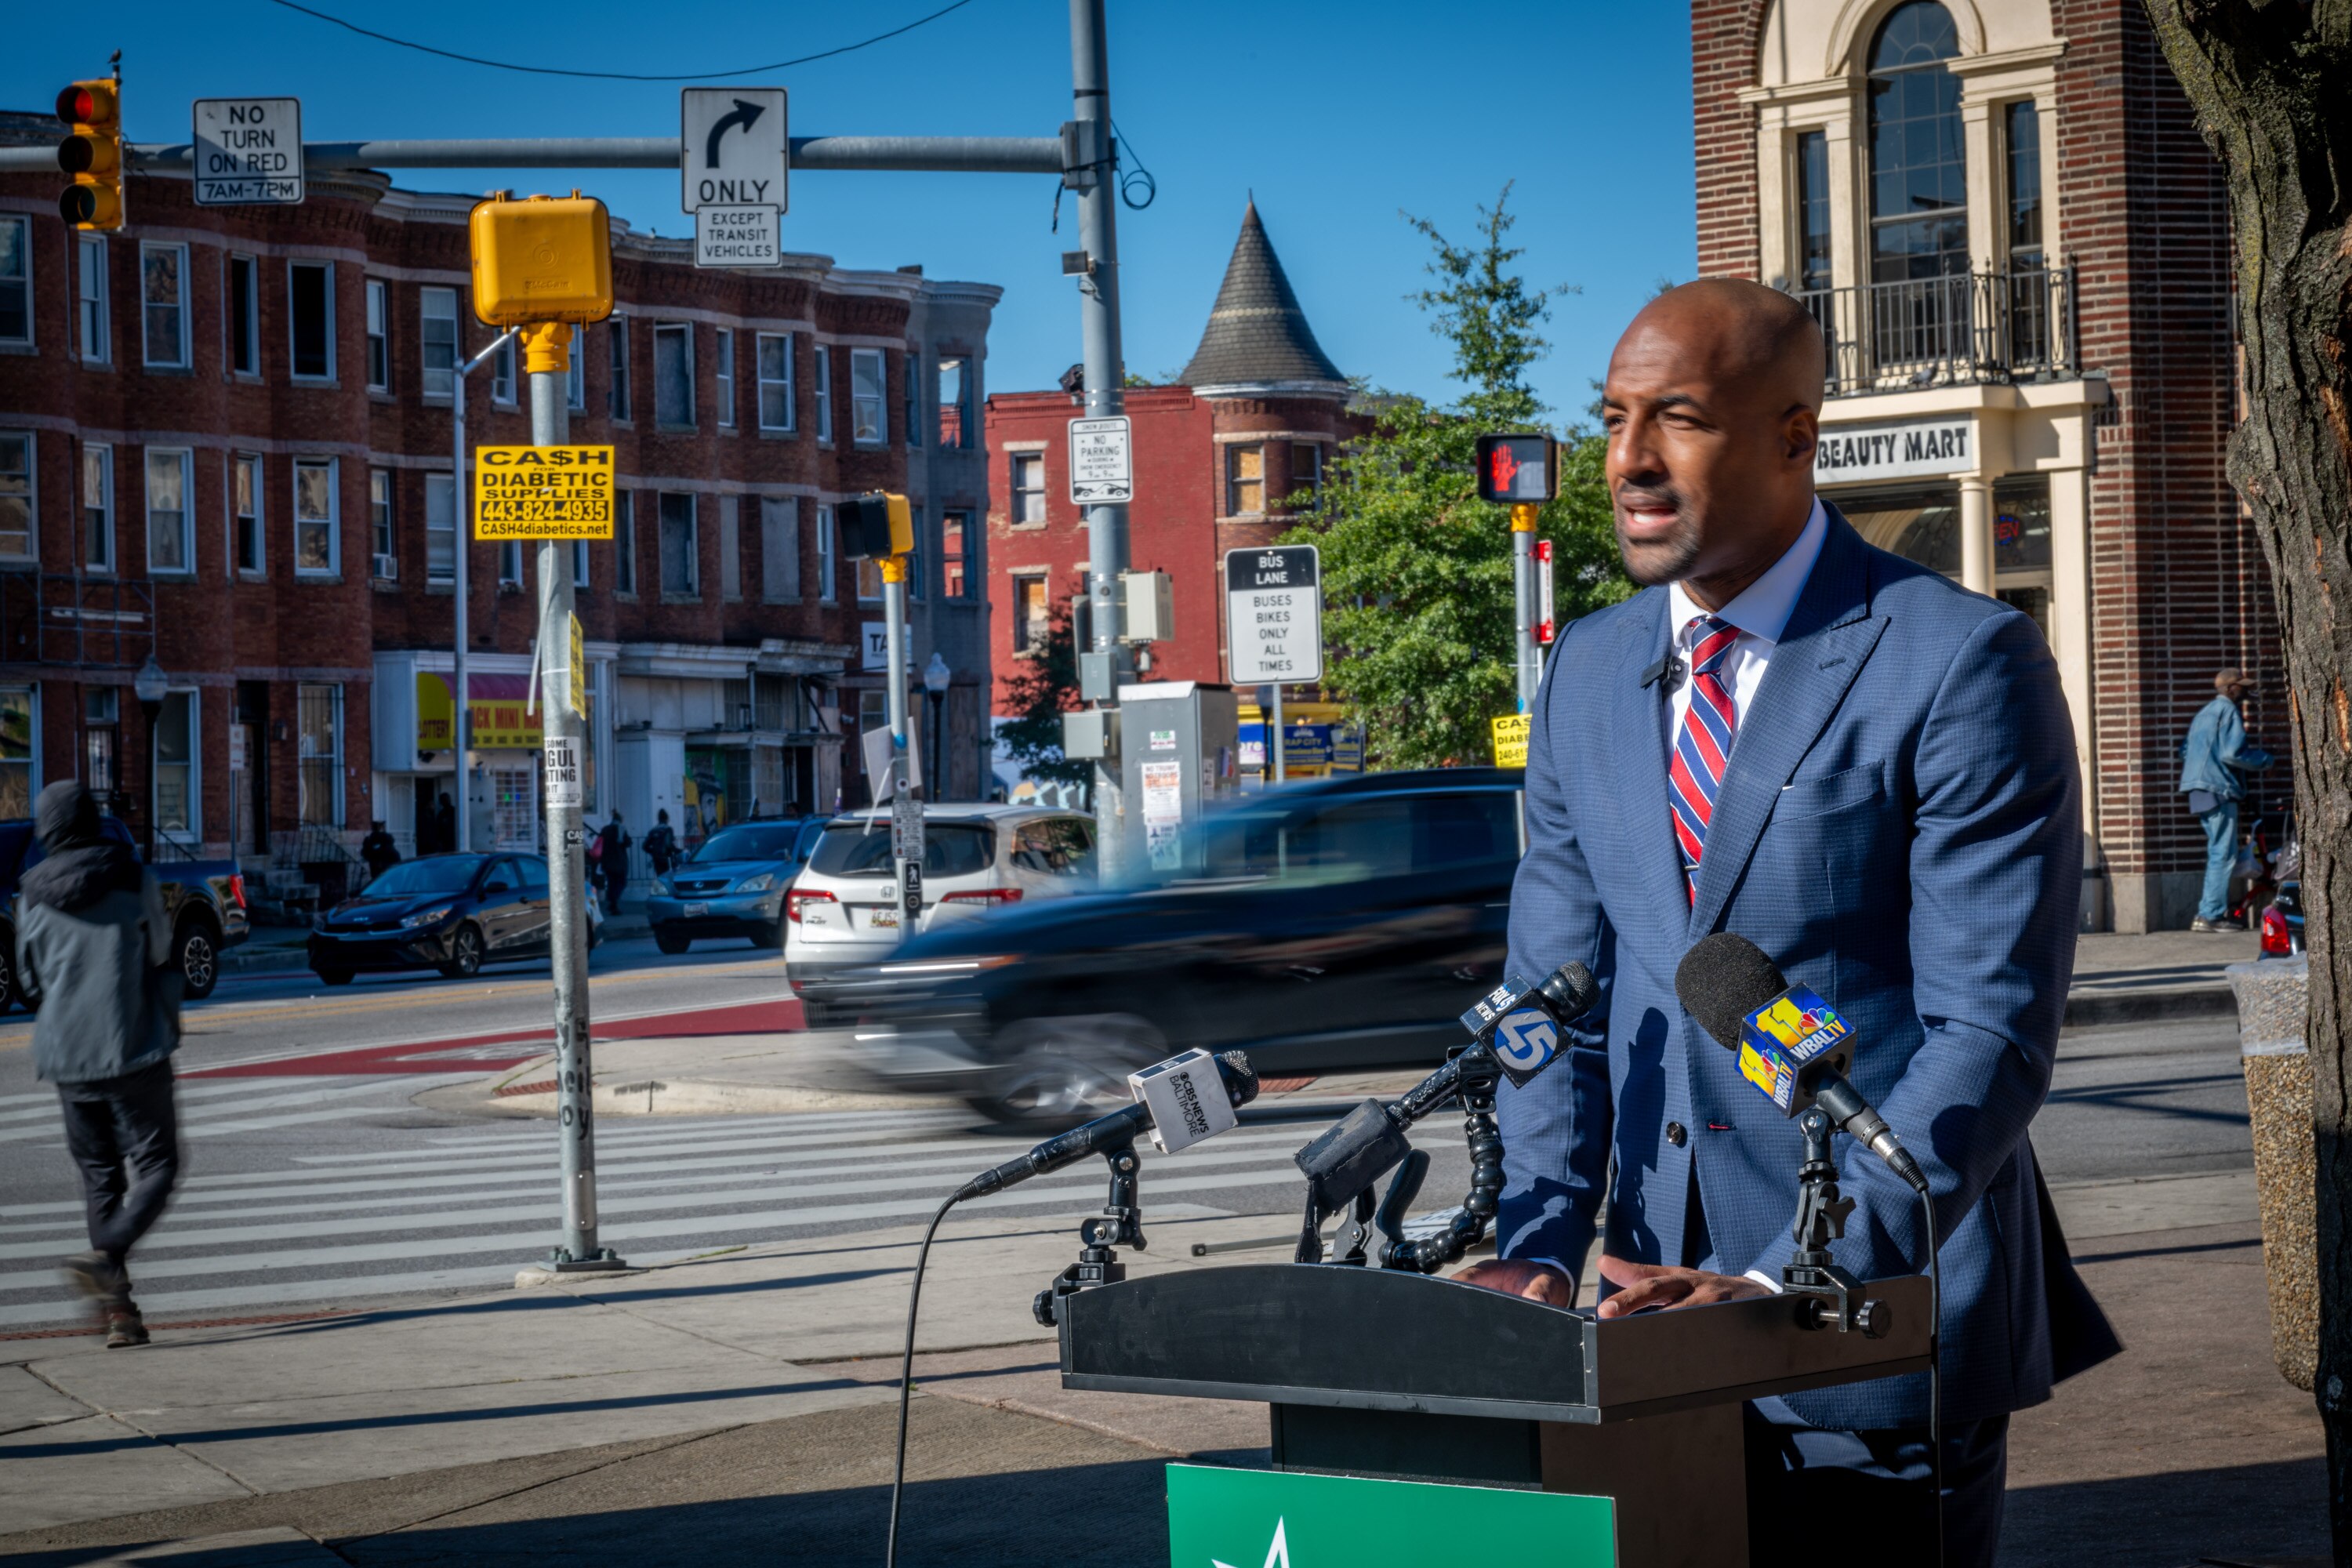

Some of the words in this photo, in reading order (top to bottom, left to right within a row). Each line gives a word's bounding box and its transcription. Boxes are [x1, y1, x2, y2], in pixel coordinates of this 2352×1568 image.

[230, 105, 265, 125] NO
[220, 129, 274, 149] TURN
[209, 153, 237, 173] ON
[247, 152, 287, 172] RED
[204, 182, 294, 198] 7AM-7PM
[699, 179, 770, 203] ONLY
[712, 212, 764, 225] EXCEPT
[708, 228, 768, 241] TRANSIT
[705, 245, 773, 257] VEHICLES
[1094, 435, 1105, 445] NO
[1081, 446, 1120, 456] PARKING
[1817, 433, 1896, 470] BEAUTY
[1904, 426, 1967, 463] MART
[483, 450, 609, 467] CA$H
[482, 472, 608, 487] DIABETIC
[485, 488, 606, 499] SUPPLIES
[482, 500, 607, 521] 443-824-4935
[481, 523, 608, 535] CASH4diabetics.net
[1258, 556, 1284, 568] BUS
[1256, 572, 1289, 585] LANE
[1254, 594, 1293, 608] BUSES
[1257, 611, 1290, 623] BIKES
[1259, 627, 1289, 640] ONLY
[869, 633, 887, 652] TA
[1264, 644, 1286, 655] ALL
[1258, 659, 1293, 672] TIMES
[495, 707, 519, 729] MINI
[546, 750, 576, 768] GUL
[1474, 1001, 1496, 1021] NEWS
[1169, 1074, 1201, 1138] BALTIMORE
[1183, 1080, 1197, 1102] CBS
[1190, 1101, 1210, 1134] NEWS
